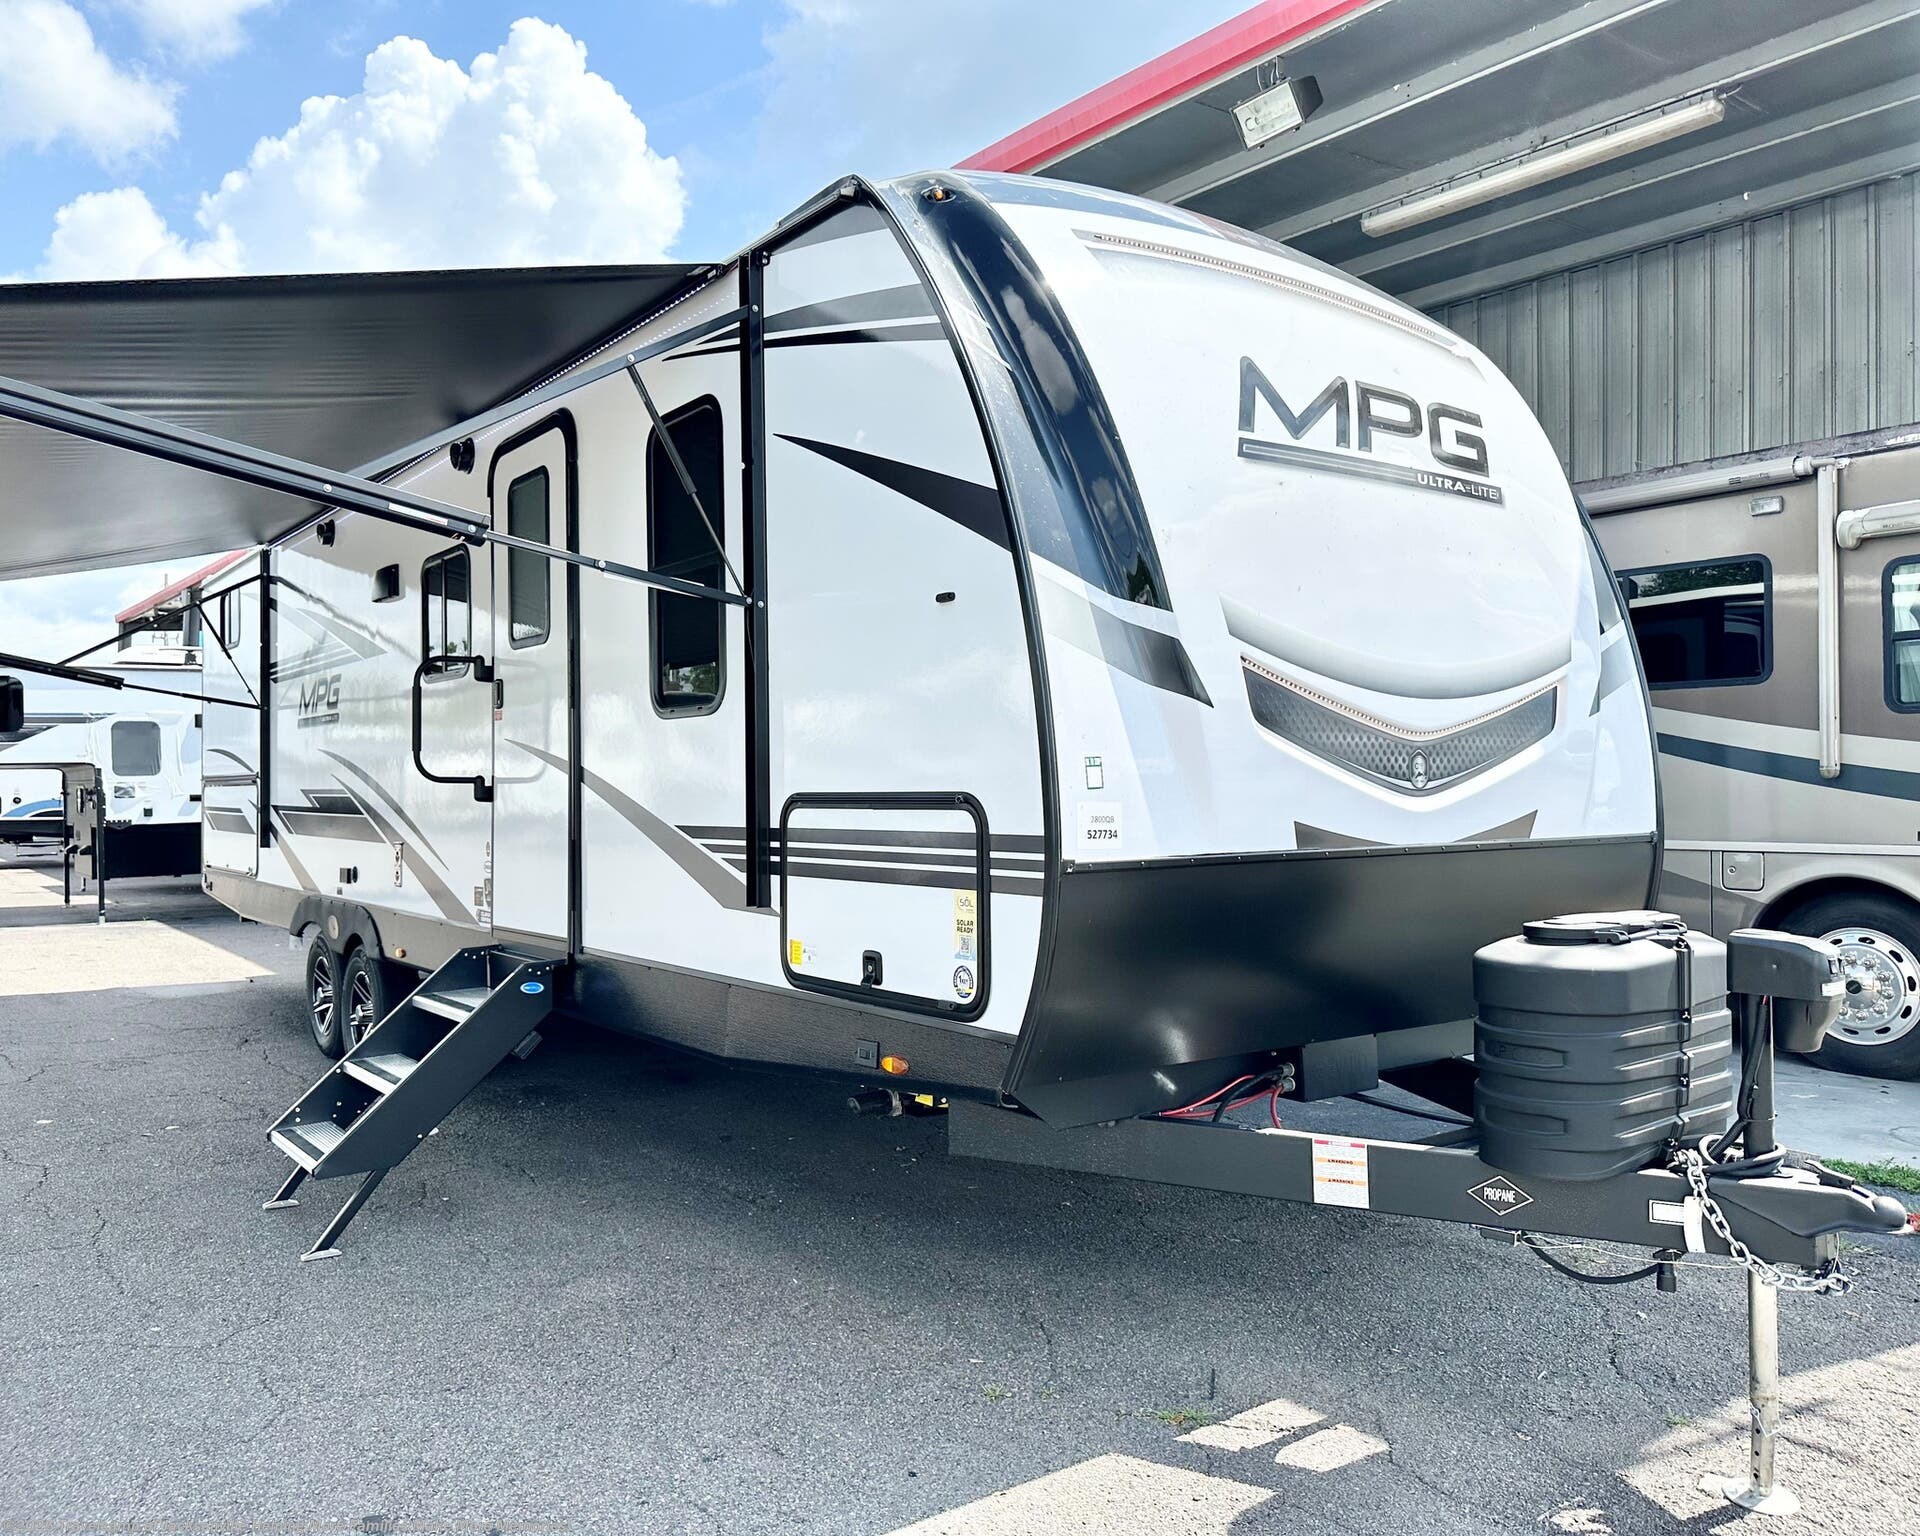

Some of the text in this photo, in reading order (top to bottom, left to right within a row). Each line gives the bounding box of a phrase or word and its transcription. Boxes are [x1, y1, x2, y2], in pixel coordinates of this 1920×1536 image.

[1238, 355, 1490, 478] MPG
[1417, 473, 1498, 499] ULTRA-LITE
[298, 673, 342, 716] MPG
[1087, 829, 1118, 839] 527734
[956, 919, 974, 927] SOLAR
[956, 926, 974, 934] READY
[1483, 1186, 1516, 1203] PROPANE
